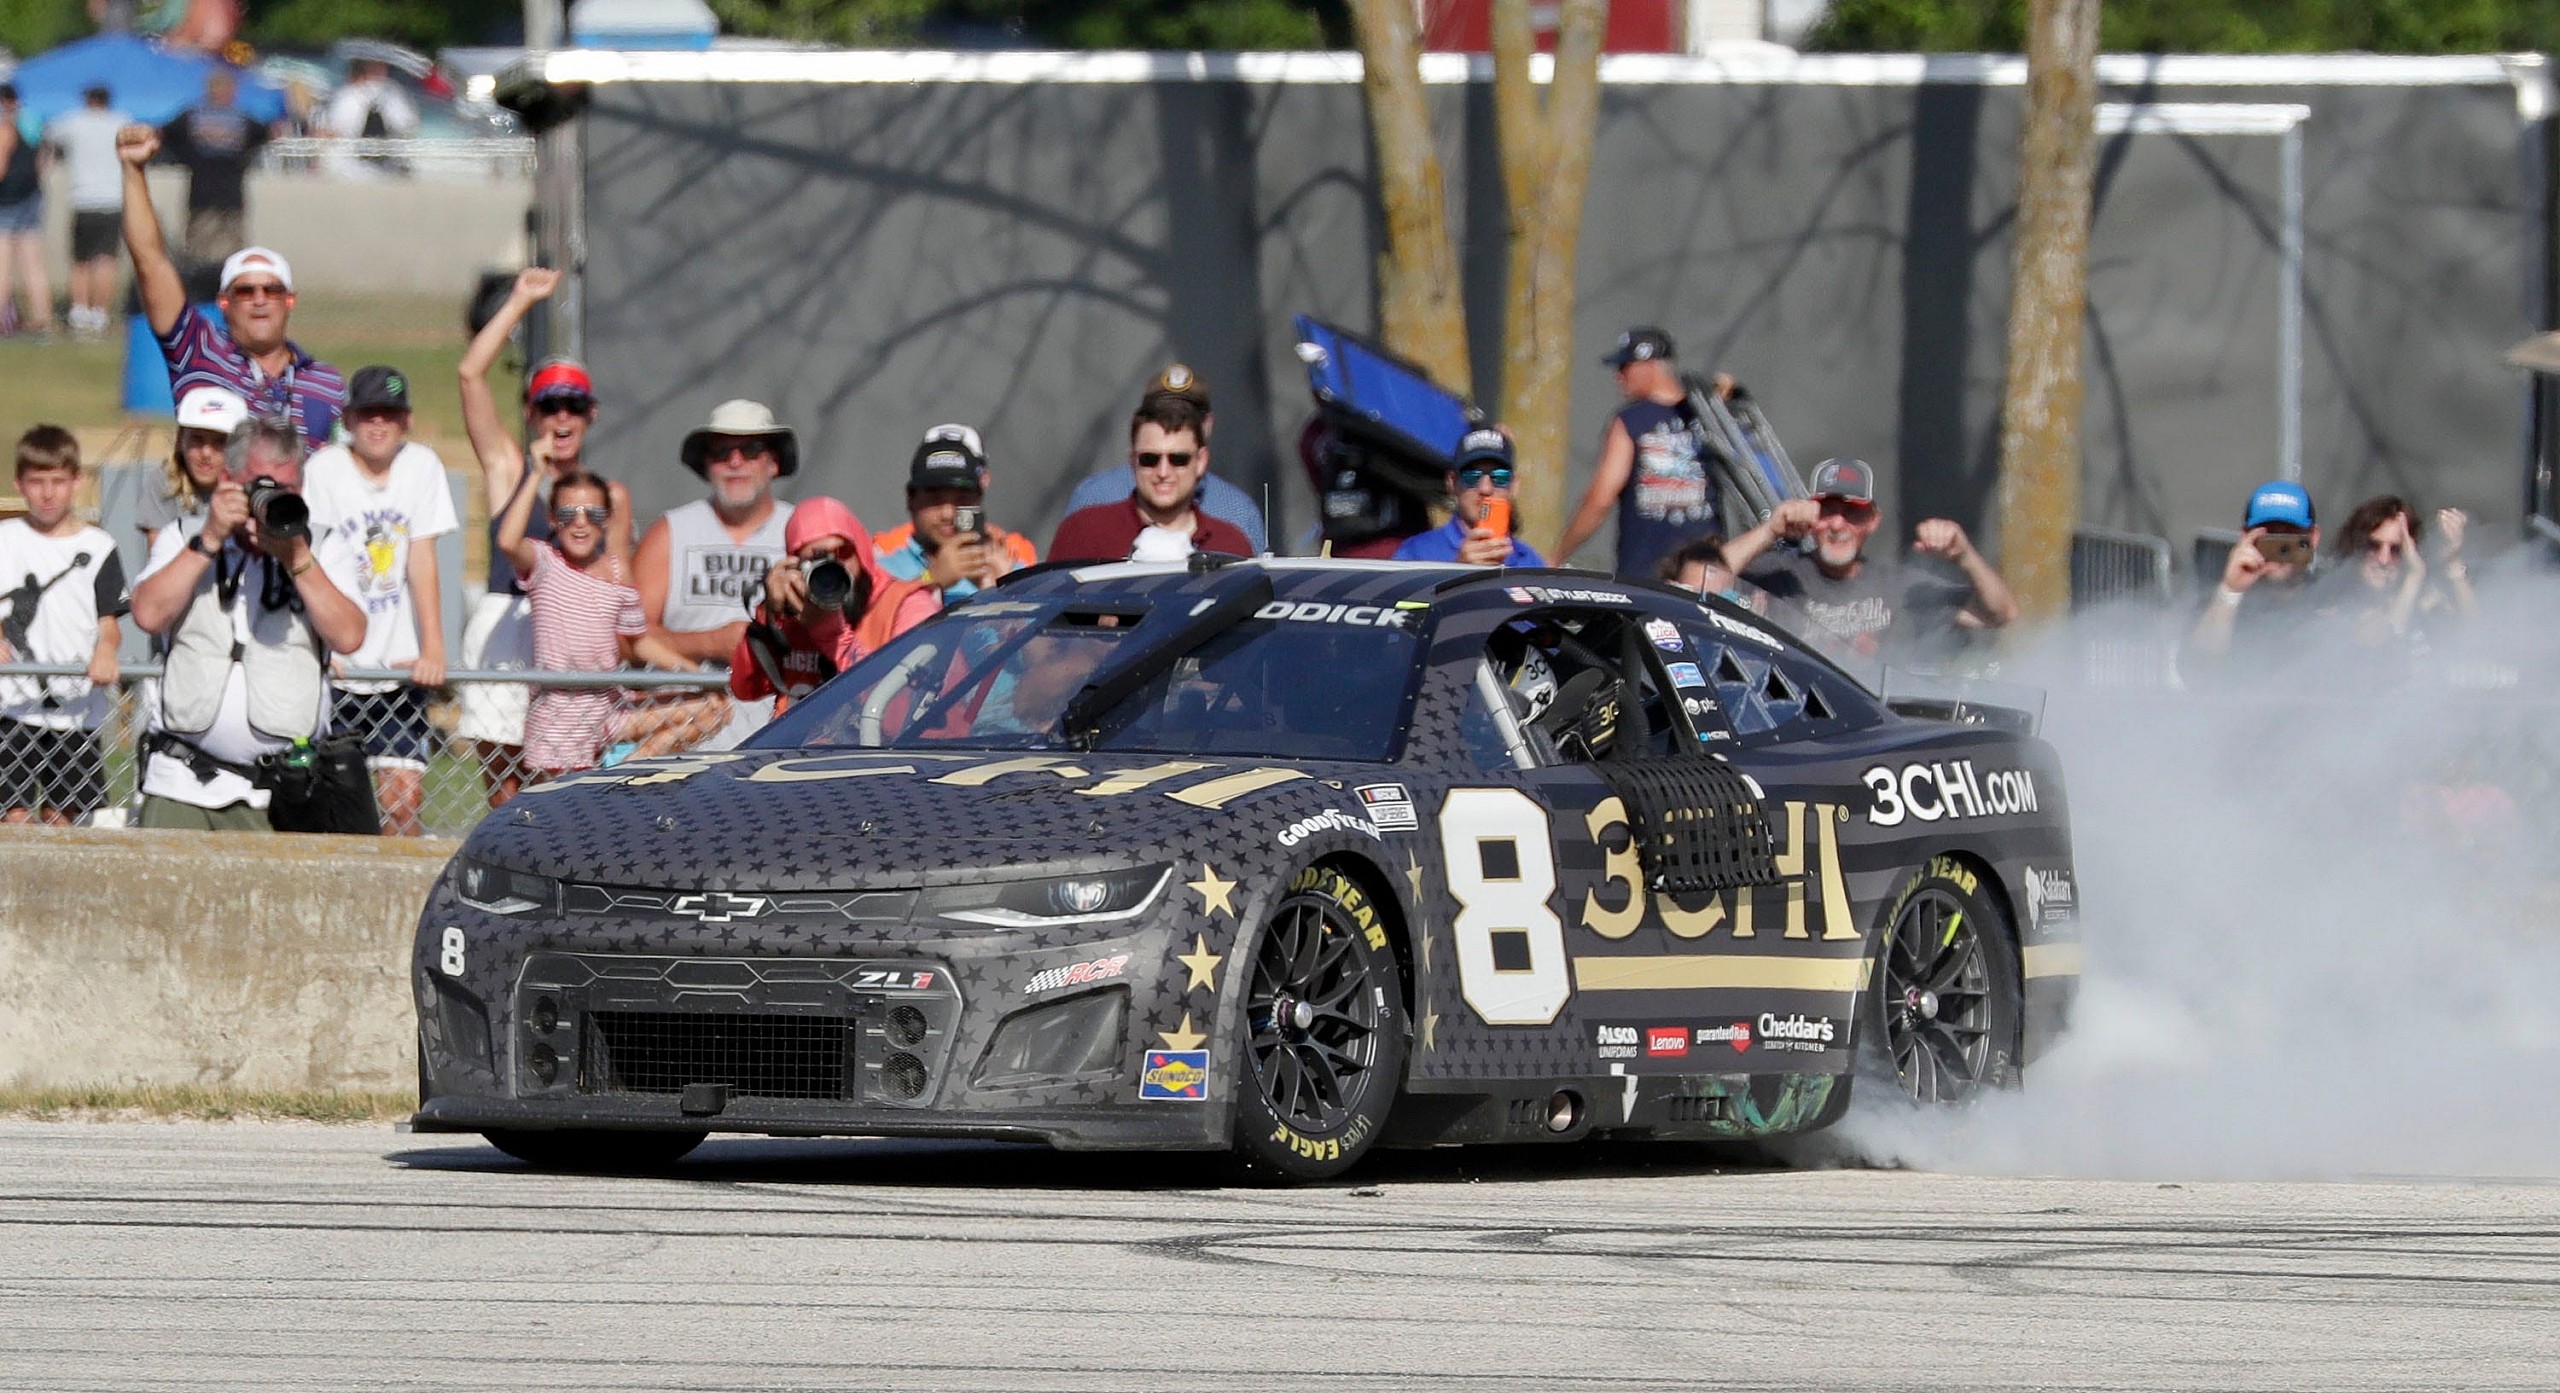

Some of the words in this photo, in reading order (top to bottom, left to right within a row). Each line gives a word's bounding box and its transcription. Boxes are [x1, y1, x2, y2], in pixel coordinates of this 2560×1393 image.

[704, 554, 768, 575] BUD
[691, 575, 763, 598] LIGH
[1862, 760, 2039, 827] 3CHI.COM
[1437, 788, 1571, 1026] 8
[441, 926, 466, 977] 8
[851, 971, 935, 989] ZL1
[1064, 955, 1130, 987] RCR
[1597, 1024, 1639, 1045] ALSCO
[1757, 1012, 1834, 1042] Cheddar's
[1599, 1045, 1638, 1059] UNIFORMS
[1650, 1034, 1686, 1051] Lenovo
[1147, 1068, 1205, 1084] SUNOCO
[1274, 1121, 1340, 1162] EAGLE
